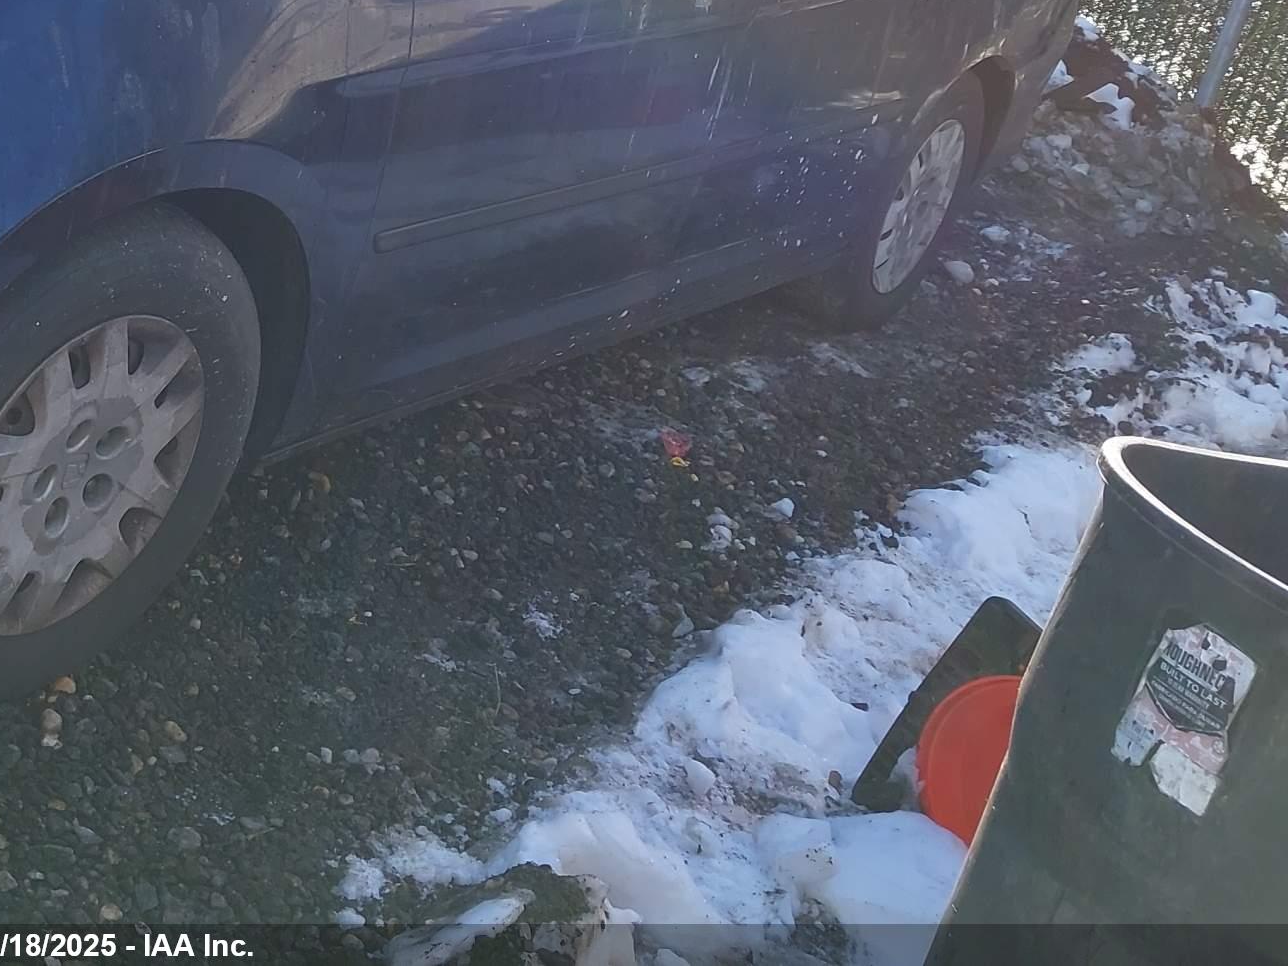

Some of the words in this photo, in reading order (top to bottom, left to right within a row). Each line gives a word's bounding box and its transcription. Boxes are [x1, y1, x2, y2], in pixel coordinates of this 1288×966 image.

[1159, 661, 1185, 683] BUILT
[1186, 680, 1200, 693] TO
[1200, 689, 1227, 710] LAST
